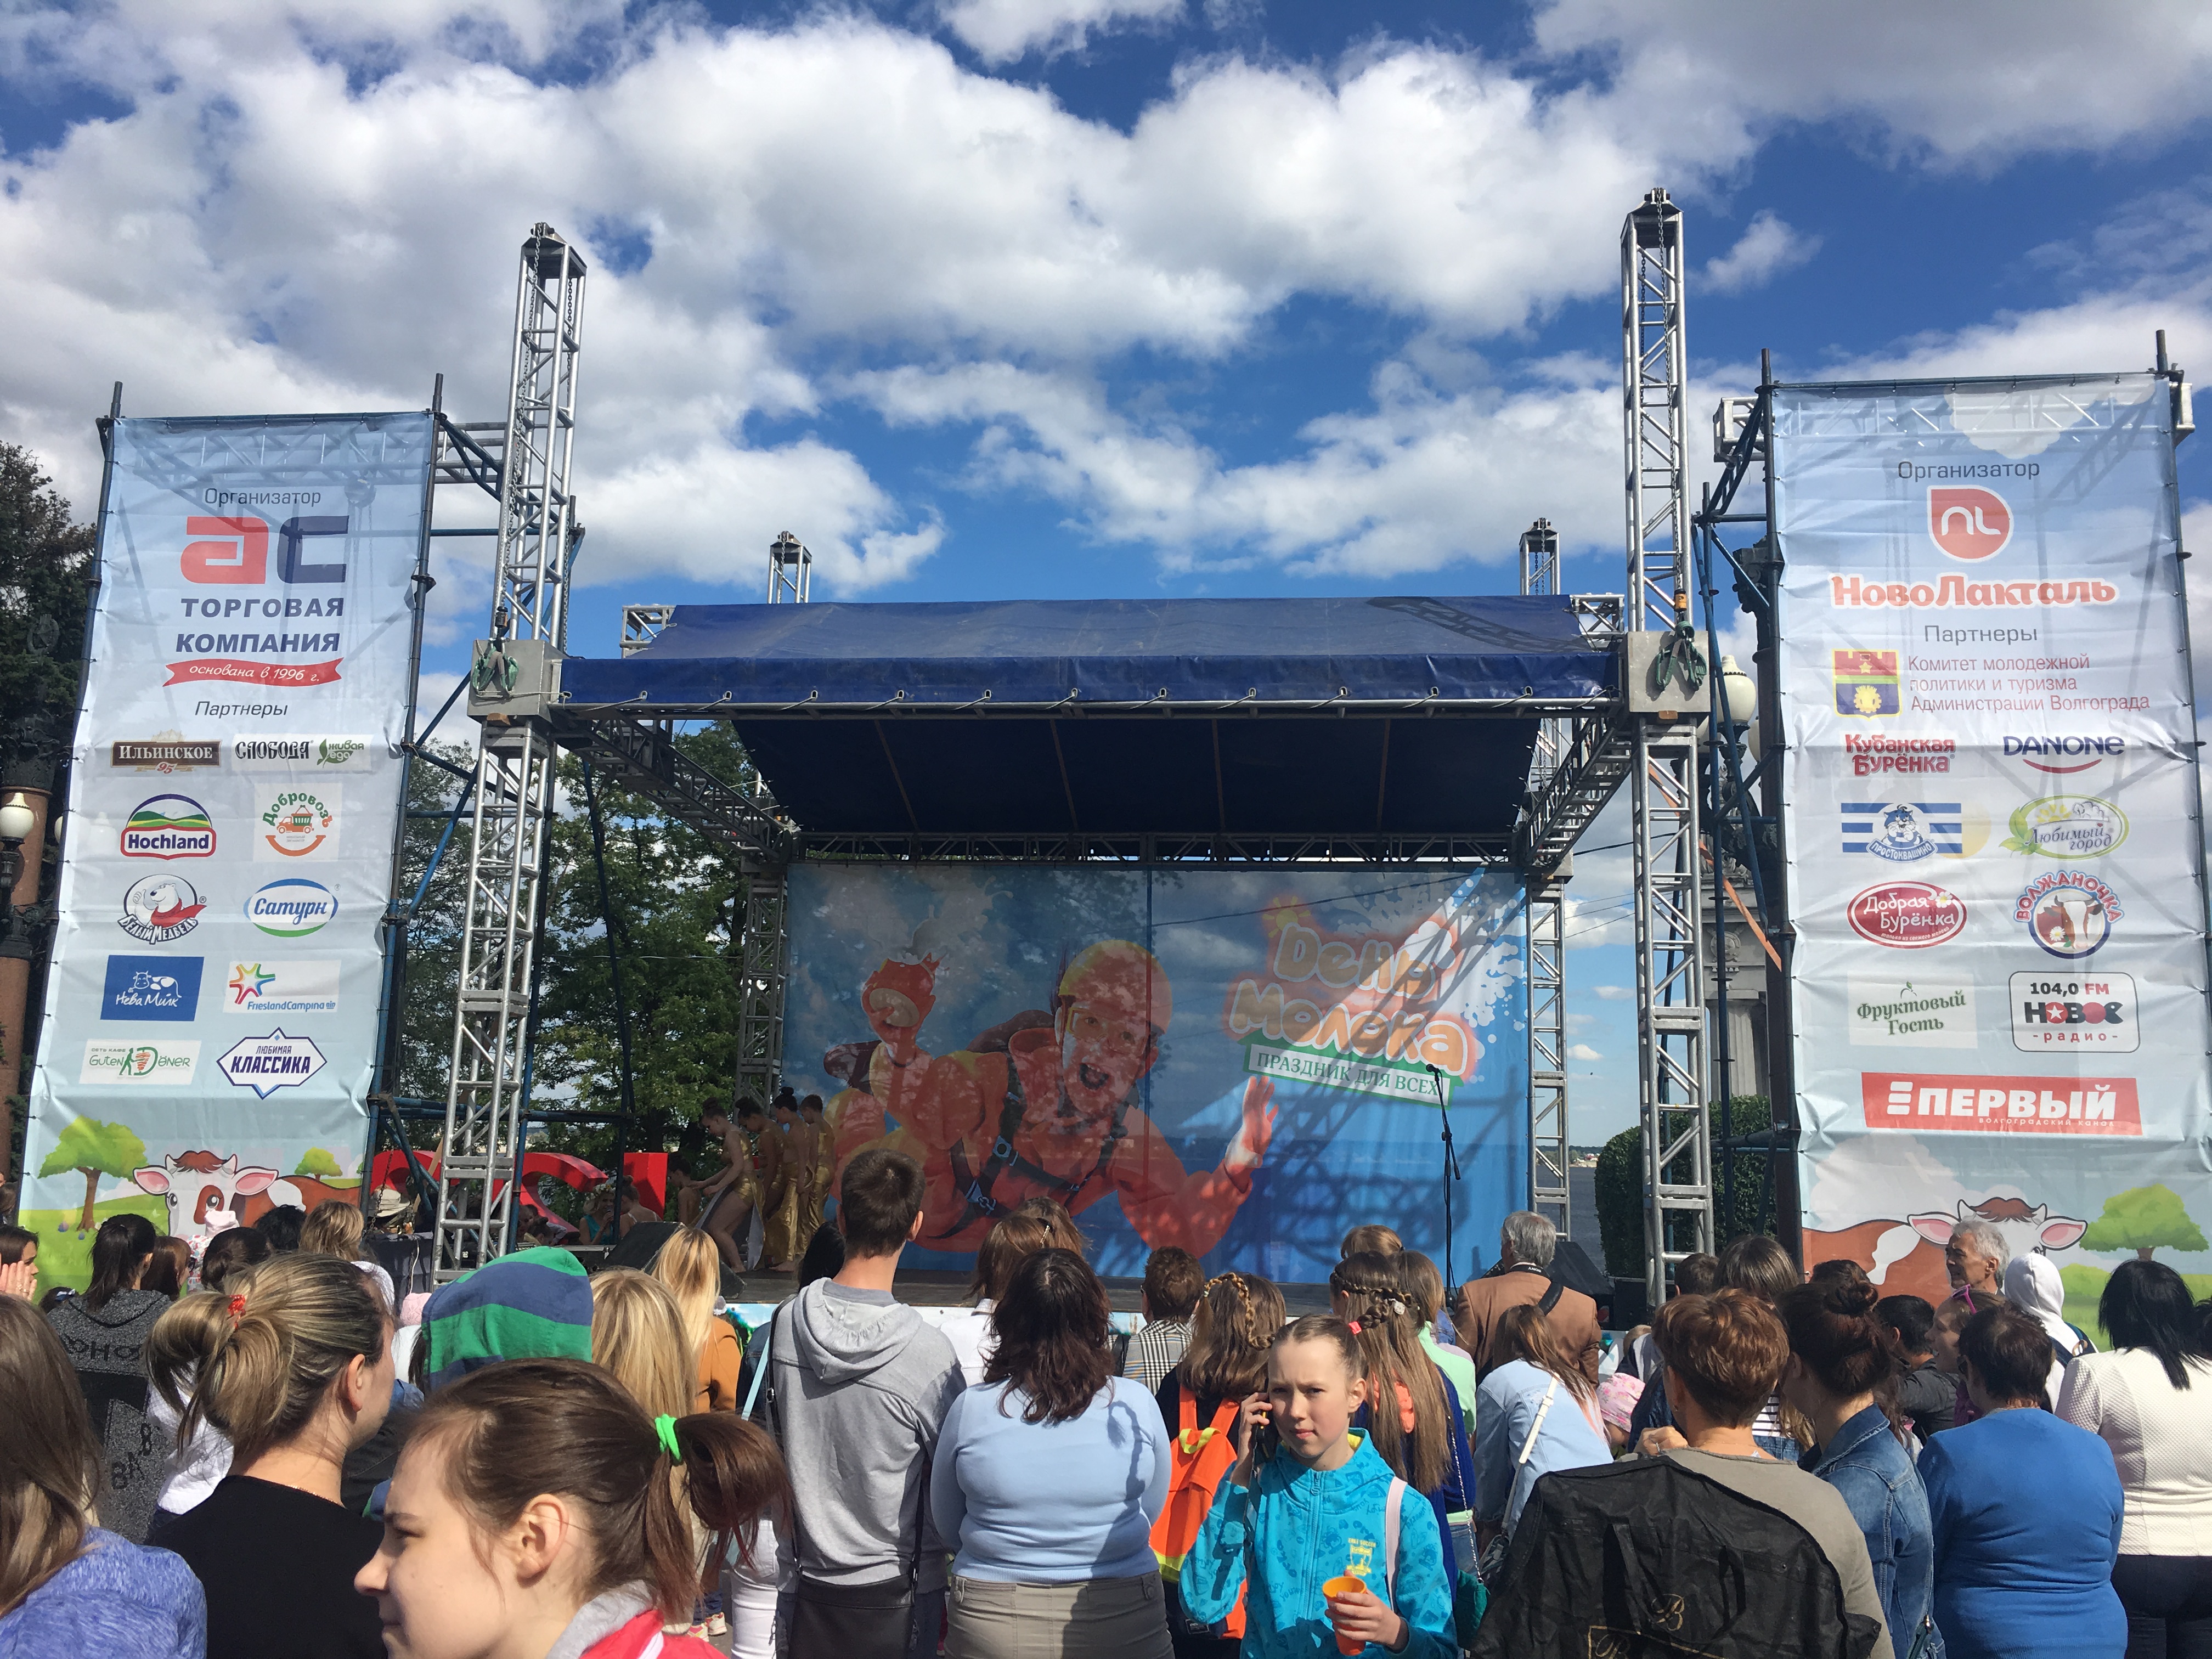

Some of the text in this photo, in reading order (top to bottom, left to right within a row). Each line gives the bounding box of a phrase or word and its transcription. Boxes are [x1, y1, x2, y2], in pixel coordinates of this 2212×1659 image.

[1898, 460, 2040, 481] Организатор
[205, 488, 321, 506] Организатор
[1831, 575, 2116, 607] НовоЛакталь
[182, 597, 343, 617] ТОРГОВАЯ
[176, 633, 340, 653] КОМПАНИЯ
[1924, 625, 2038, 646] Партнеры
[1908, 653, 2090, 673] Комитет молодежной
[189, 665, 319, 682] основана в 1996 г.
[1910, 676, 2077, 694] политики и туризма
[195, 701, 288, 718] Партнеры
[1911, 693, 2150, 712] Администрации Волгограда
[119, 746, 213, 759] ИЛЬИНСКОЕ
[234, 741, 310, 759] СЛОБОДА
[329, 740, 364, 750] живая
[1845, 734, 1956, 754] Кубанская
[2003, 736, 2125, 755] DANONE
[157, 763, 174, 774] 95
[1852, 753, 1950, 777] Бурёнка
[128, 834, 209, 849] Hochland
[2070, 834, 2112, 852] город
[1871, 842, 1932, 860] ПРОСТОКВАШИНО
[1864, 893, 1929, 916] Добрая
[2016, 872, 2123, 922] ВОЛЖАНОЧКА
[254, 898, 328, 925] Сатурн
[1881, 912, 1955, 934] Бурёнка
[116, 991, 143, 1006] Нева
[2030, 983, 2109, 997] 104,0 FM
[247, 1001, 324, 1012] FrieslandCampina
[1857, 990, 1966, 1021] Фруктовый
[1889, 1019, 1944, 1036] Гость
[255, 1046, 292, 1054] ЛЮБИМАЯ
[230, 1056, 311, 1074] КЛАССИКА
[1257, 1052, 1438, 1096] ПРАЗДНИК ДЛЯ ВСЕХ
[1917, 1084, 2117, 1120] ПЕРВЫЙ
